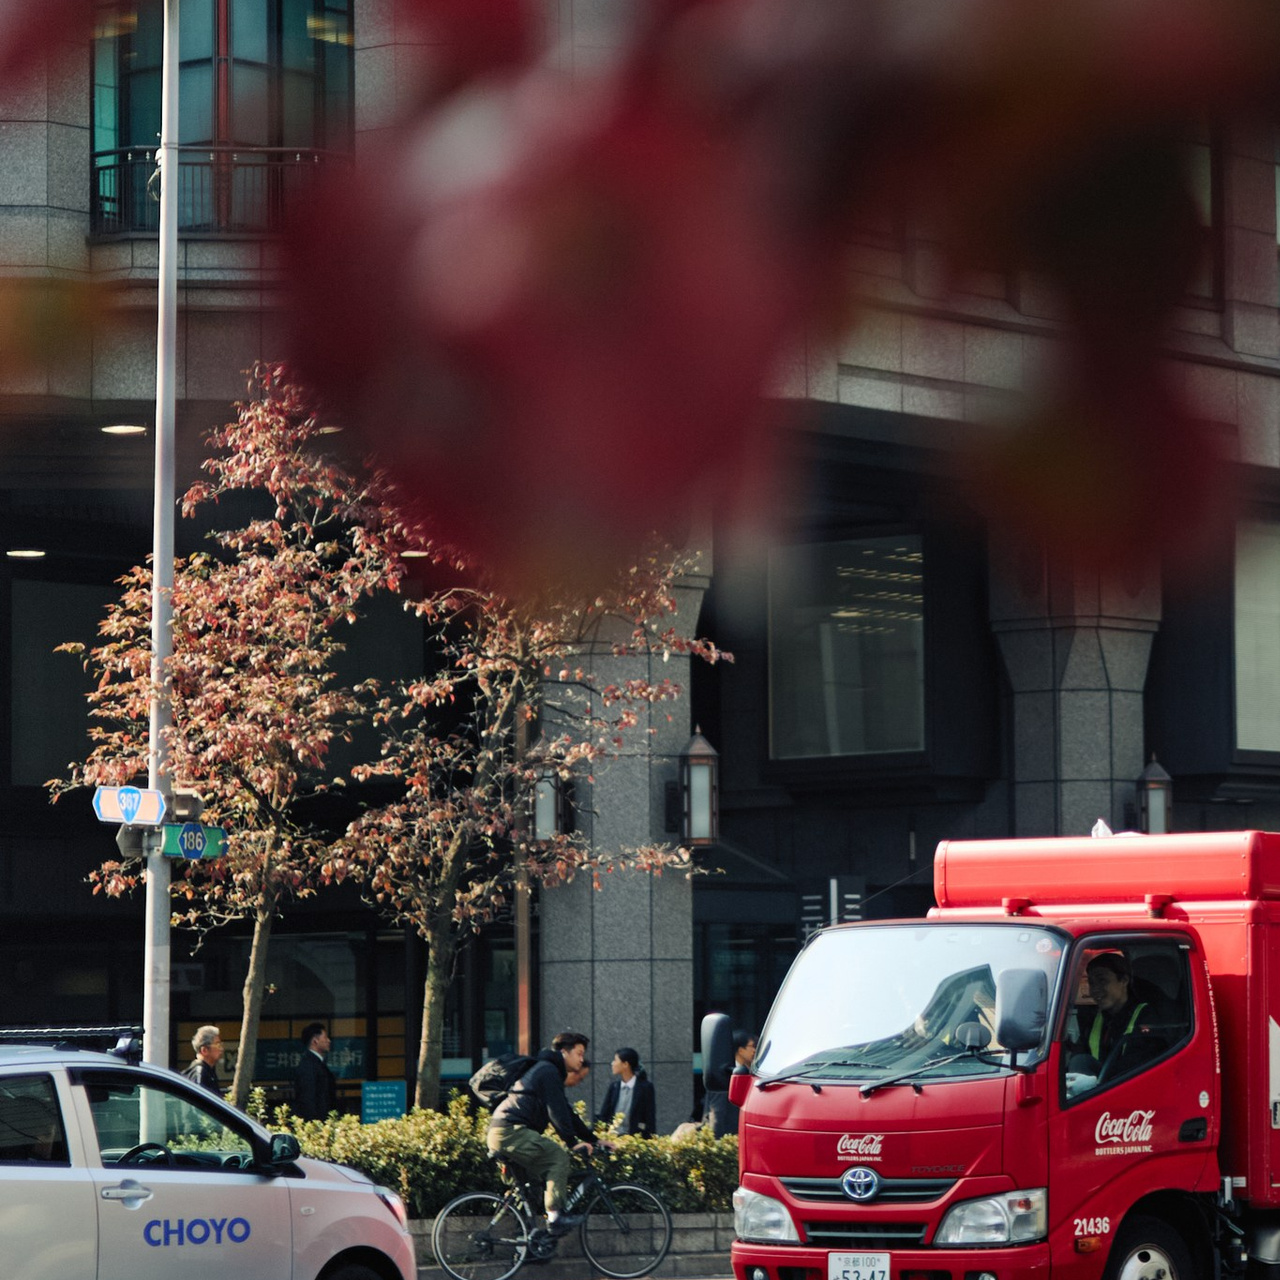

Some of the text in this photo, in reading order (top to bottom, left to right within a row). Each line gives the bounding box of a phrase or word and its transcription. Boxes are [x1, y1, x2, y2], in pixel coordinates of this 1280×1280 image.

[182, 832, 203, 851] 186
[1095, 1110, 1156, 1144] Coca-Cola
[837, 1133, 885, 1155] Coca-Cola
[1095, 1147, 1124, 1156] BOTTLERS
[1124, 1145, 1142, 1155] JAPAN
[143, 1217, 251, 1247] CHOYO
[1073, 1216, 1110, 1236] 21436
